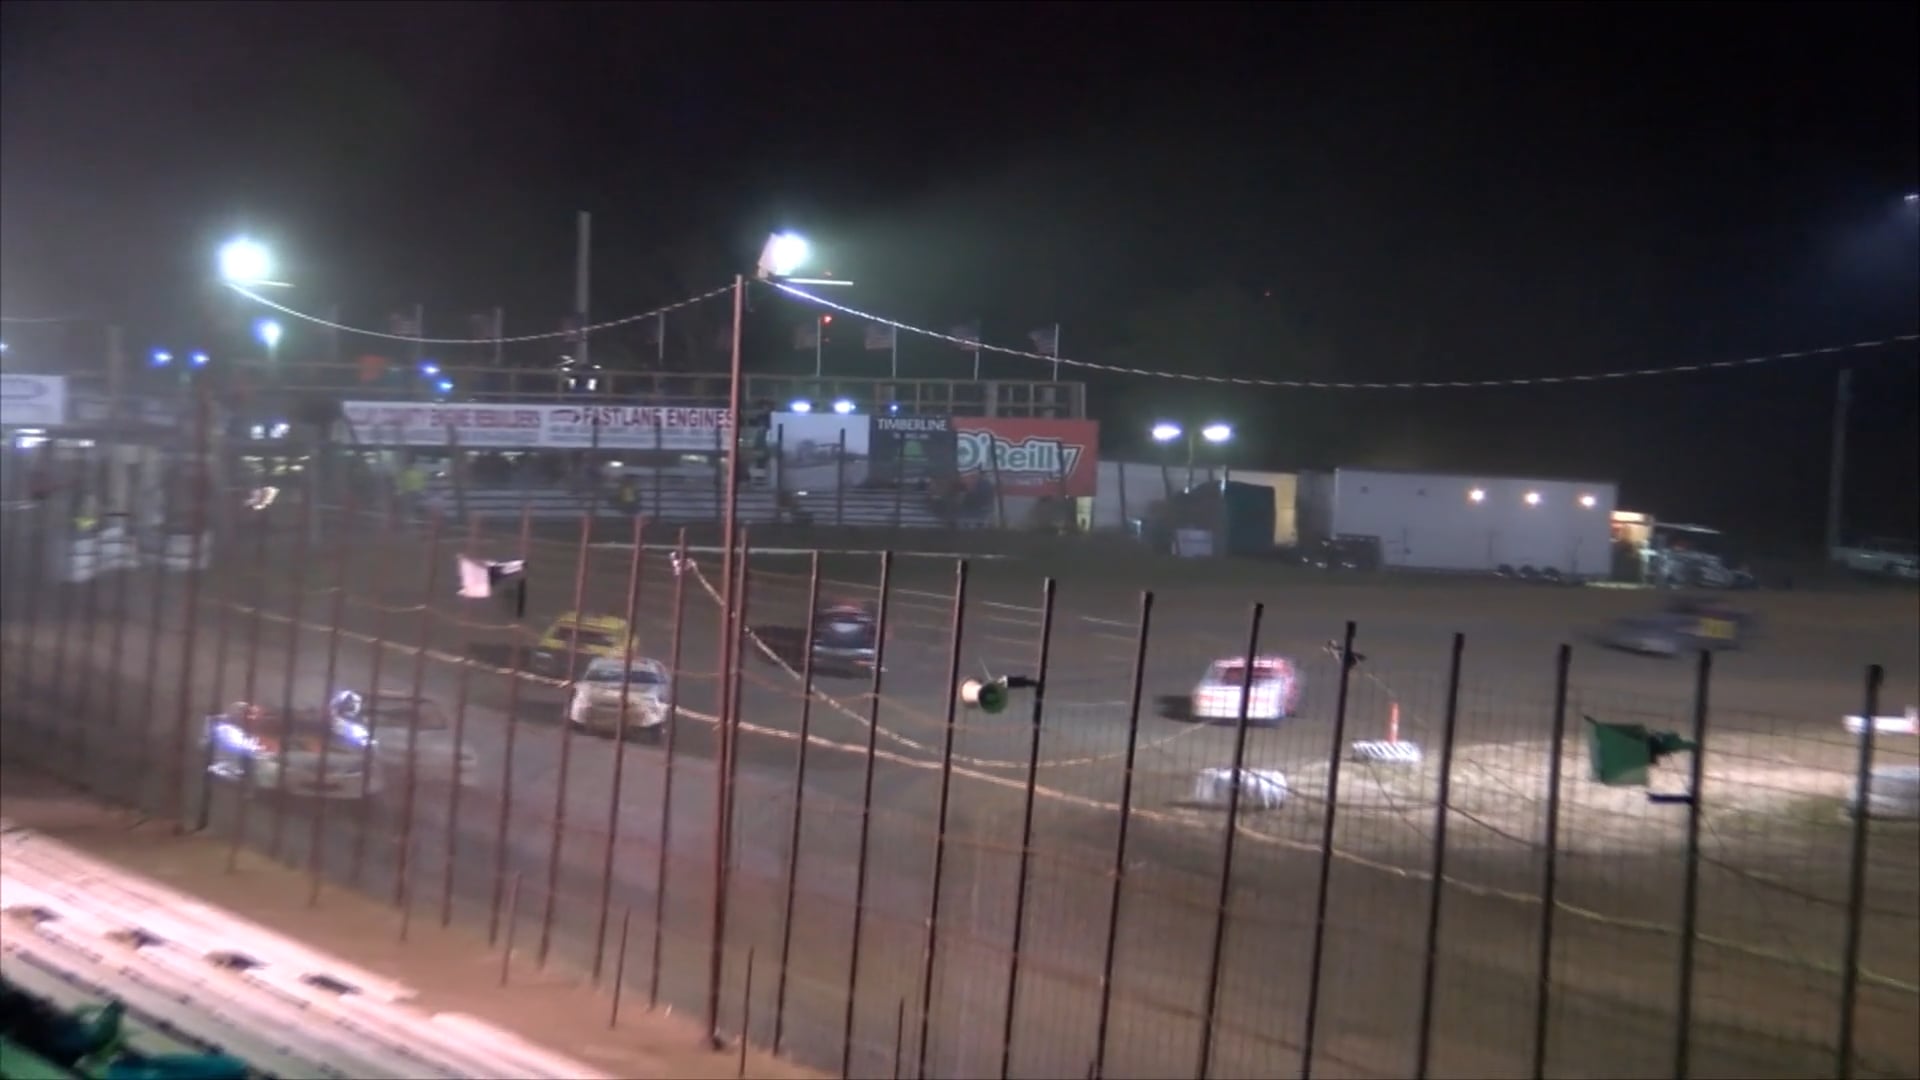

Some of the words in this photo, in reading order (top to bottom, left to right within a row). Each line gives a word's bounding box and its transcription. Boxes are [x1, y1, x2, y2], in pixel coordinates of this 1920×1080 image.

[667, 408, 734, 428] ENGINES
[876, 417, 947, 431] TIMBERLINE
[957, 432, 1077, 474] O'Reilly
